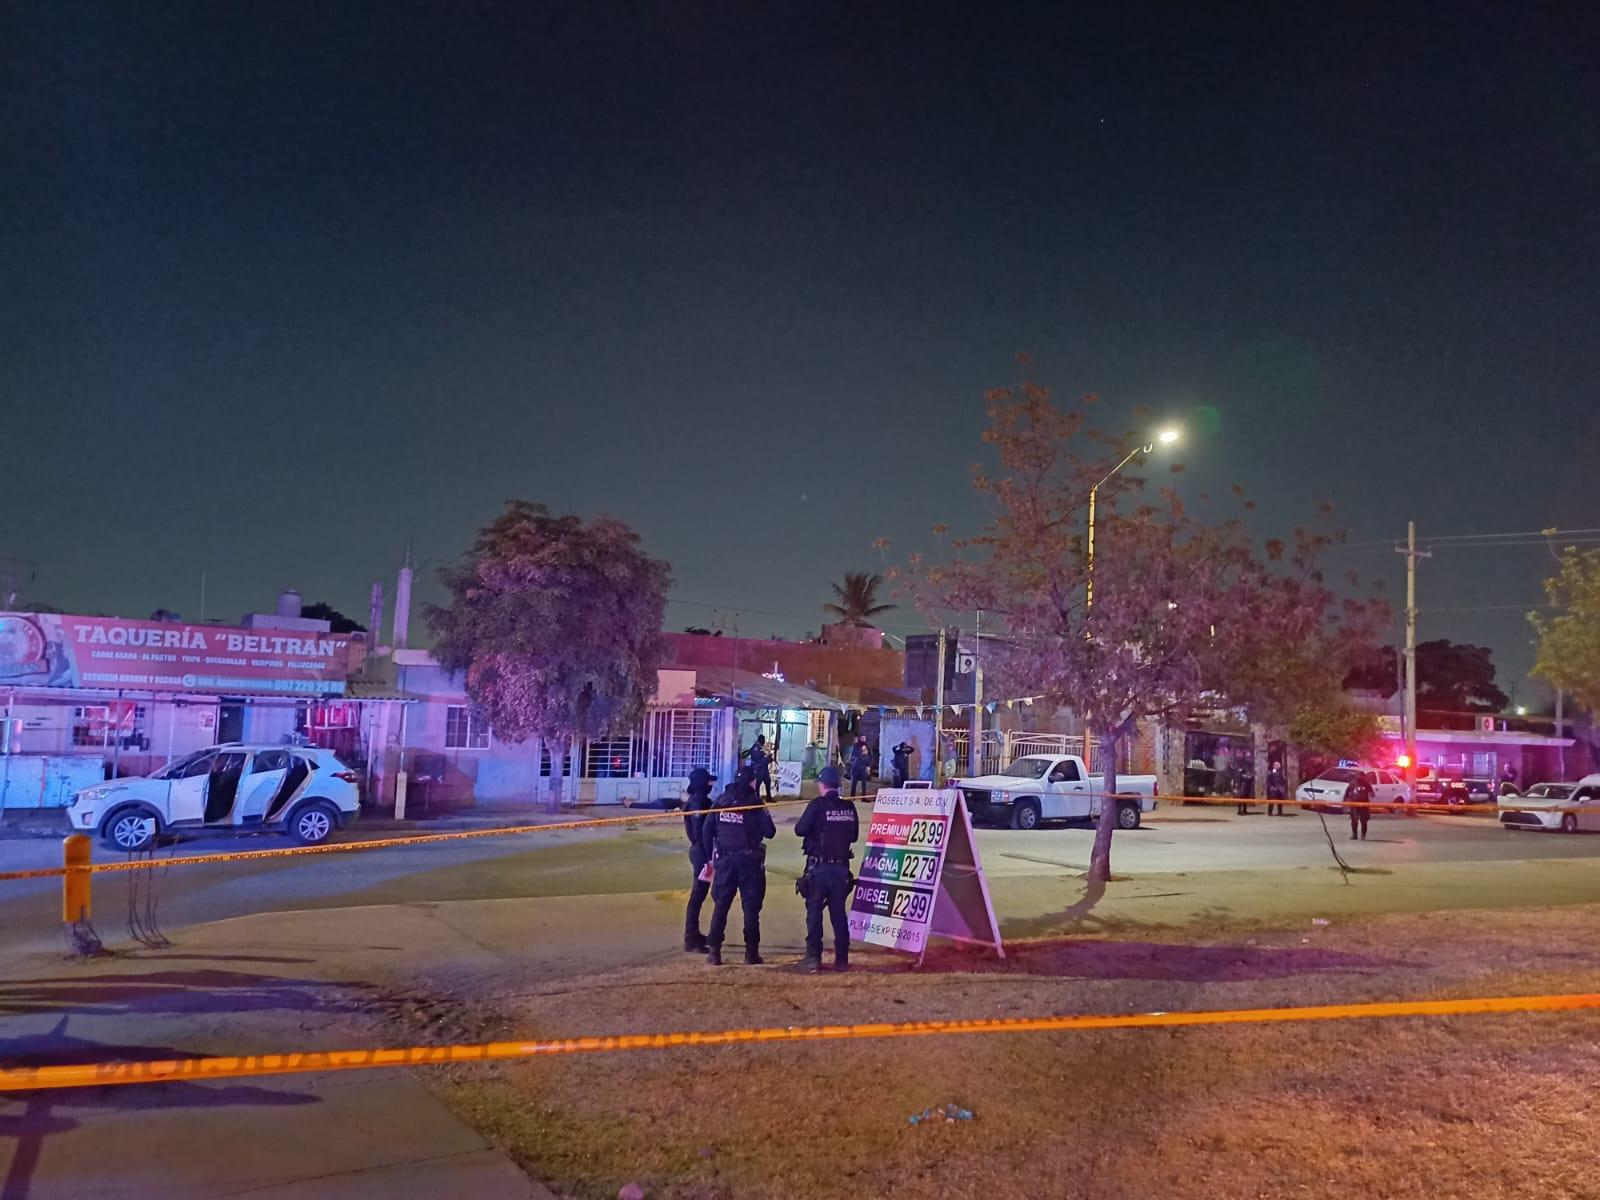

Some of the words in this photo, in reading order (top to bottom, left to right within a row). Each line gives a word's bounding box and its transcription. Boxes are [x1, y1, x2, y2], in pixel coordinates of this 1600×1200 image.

[73, 625, 207, 649] TAQUERÍA
[870, 823, 910, 836] PREMIUM
[863, 856, 899, 872] MAGNA
[856, 886, 890, 905] DIESEL
